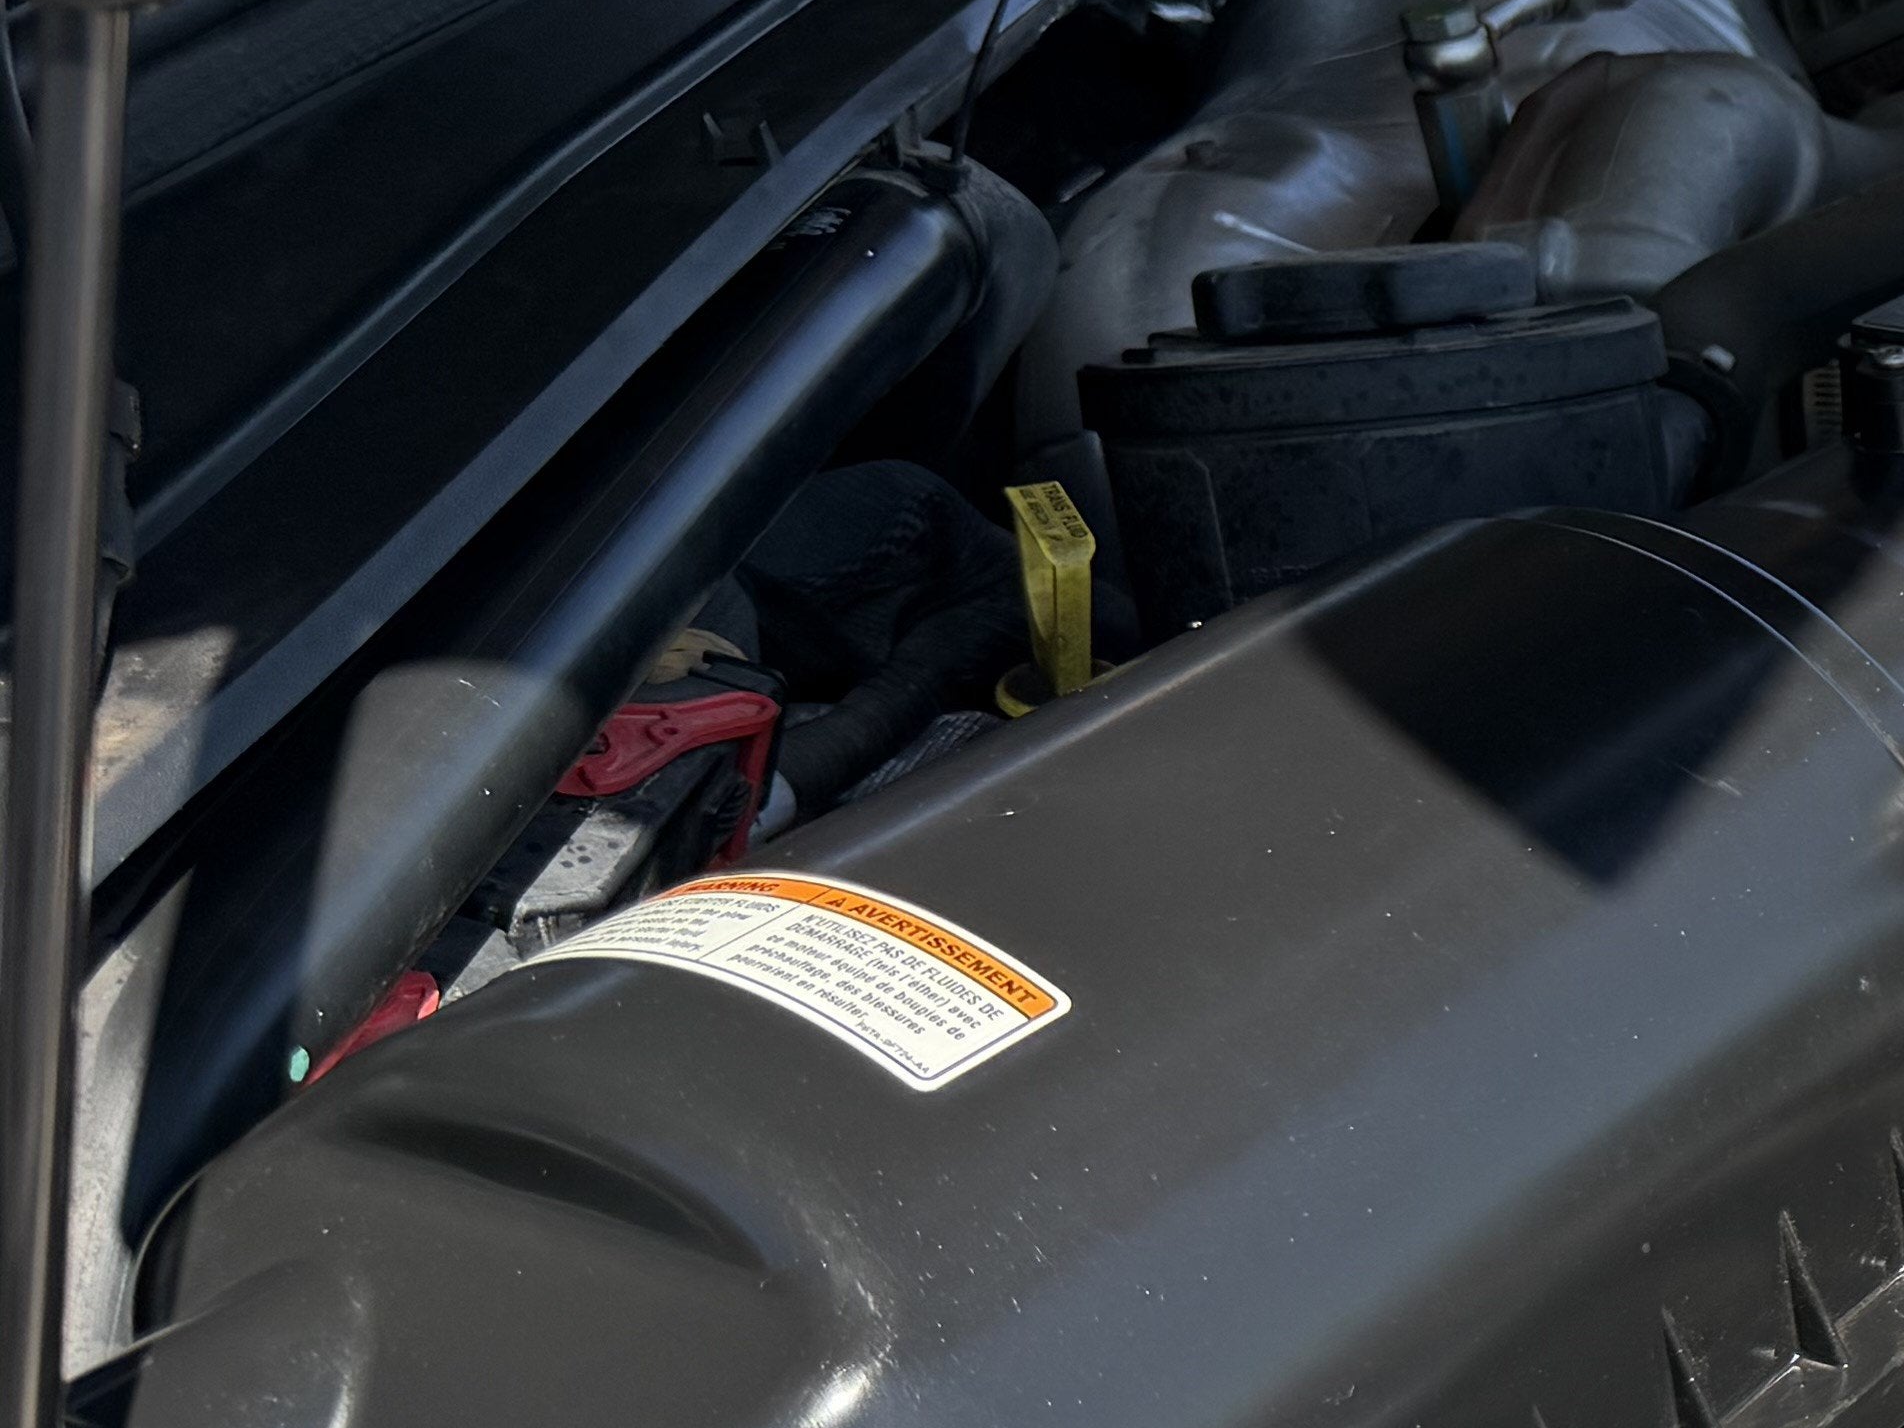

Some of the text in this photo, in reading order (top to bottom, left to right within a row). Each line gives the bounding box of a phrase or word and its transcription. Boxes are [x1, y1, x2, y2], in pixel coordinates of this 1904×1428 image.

[784, 939, 832, 962] moteur
[875, 978, 895, 995] de
[894, 987, 947, 1027] bougies
[946, 1023, 966, 1041] de
[796, 978, 816, 991] en
[801, 913, 1004, 1021] N'UTILISEZ PAS DE FLUIDES DE
[848, 901, 1038, 1005] AVERTISSEMENT
[835, 979, 862, 996] des
[860, 992, 926, 1035] blessures
[948, 1003, 981, 1030] avec
